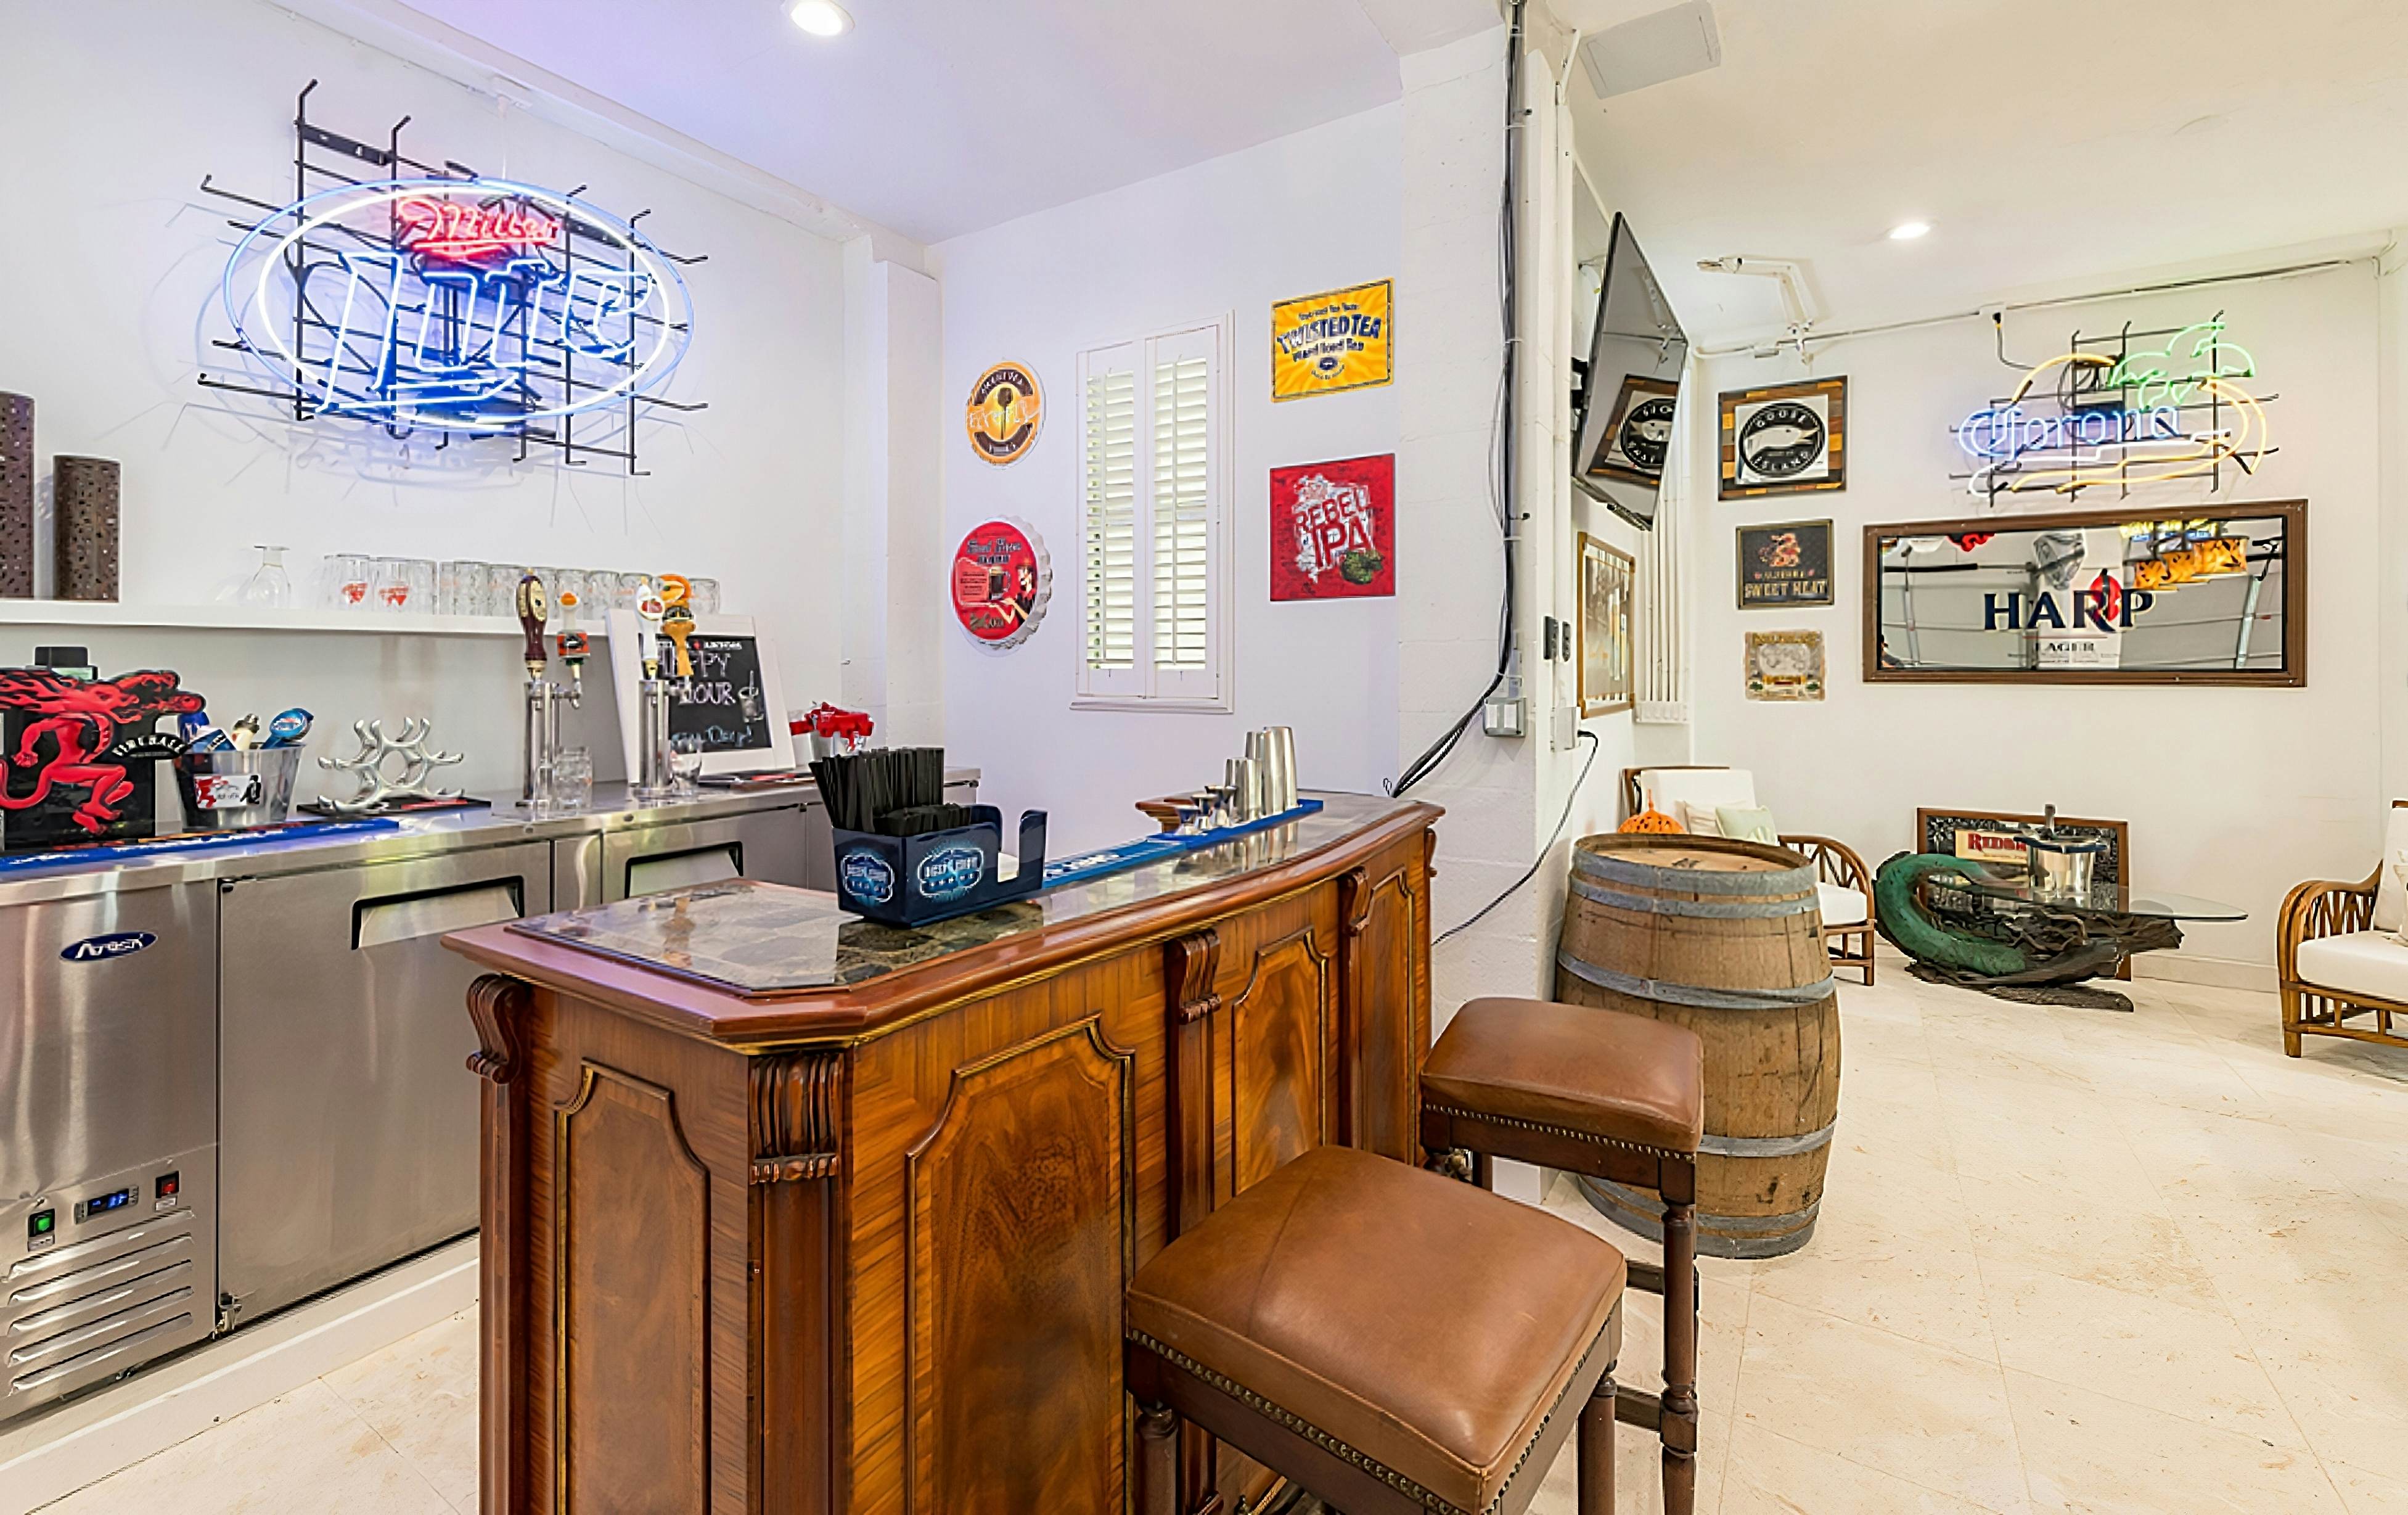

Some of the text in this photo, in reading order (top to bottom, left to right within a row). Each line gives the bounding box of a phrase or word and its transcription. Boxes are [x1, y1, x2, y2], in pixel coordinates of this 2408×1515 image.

[397, 194, 560, 244] Miller
[315, 250, 653, 413] Lite
[1277, 313, 1382, 354] TWISTED TEA
[1756, 409, 1806, 428] GOOSE
[1959, 405, 2179, 461] Corona
[1295, 486, 1372, 534] REBEL
[1311, 515, 1372, 567] IPA
[1744, 579, 1827, 599] SWEET HEAT
[1984, 589, 2155, 633] HARP
